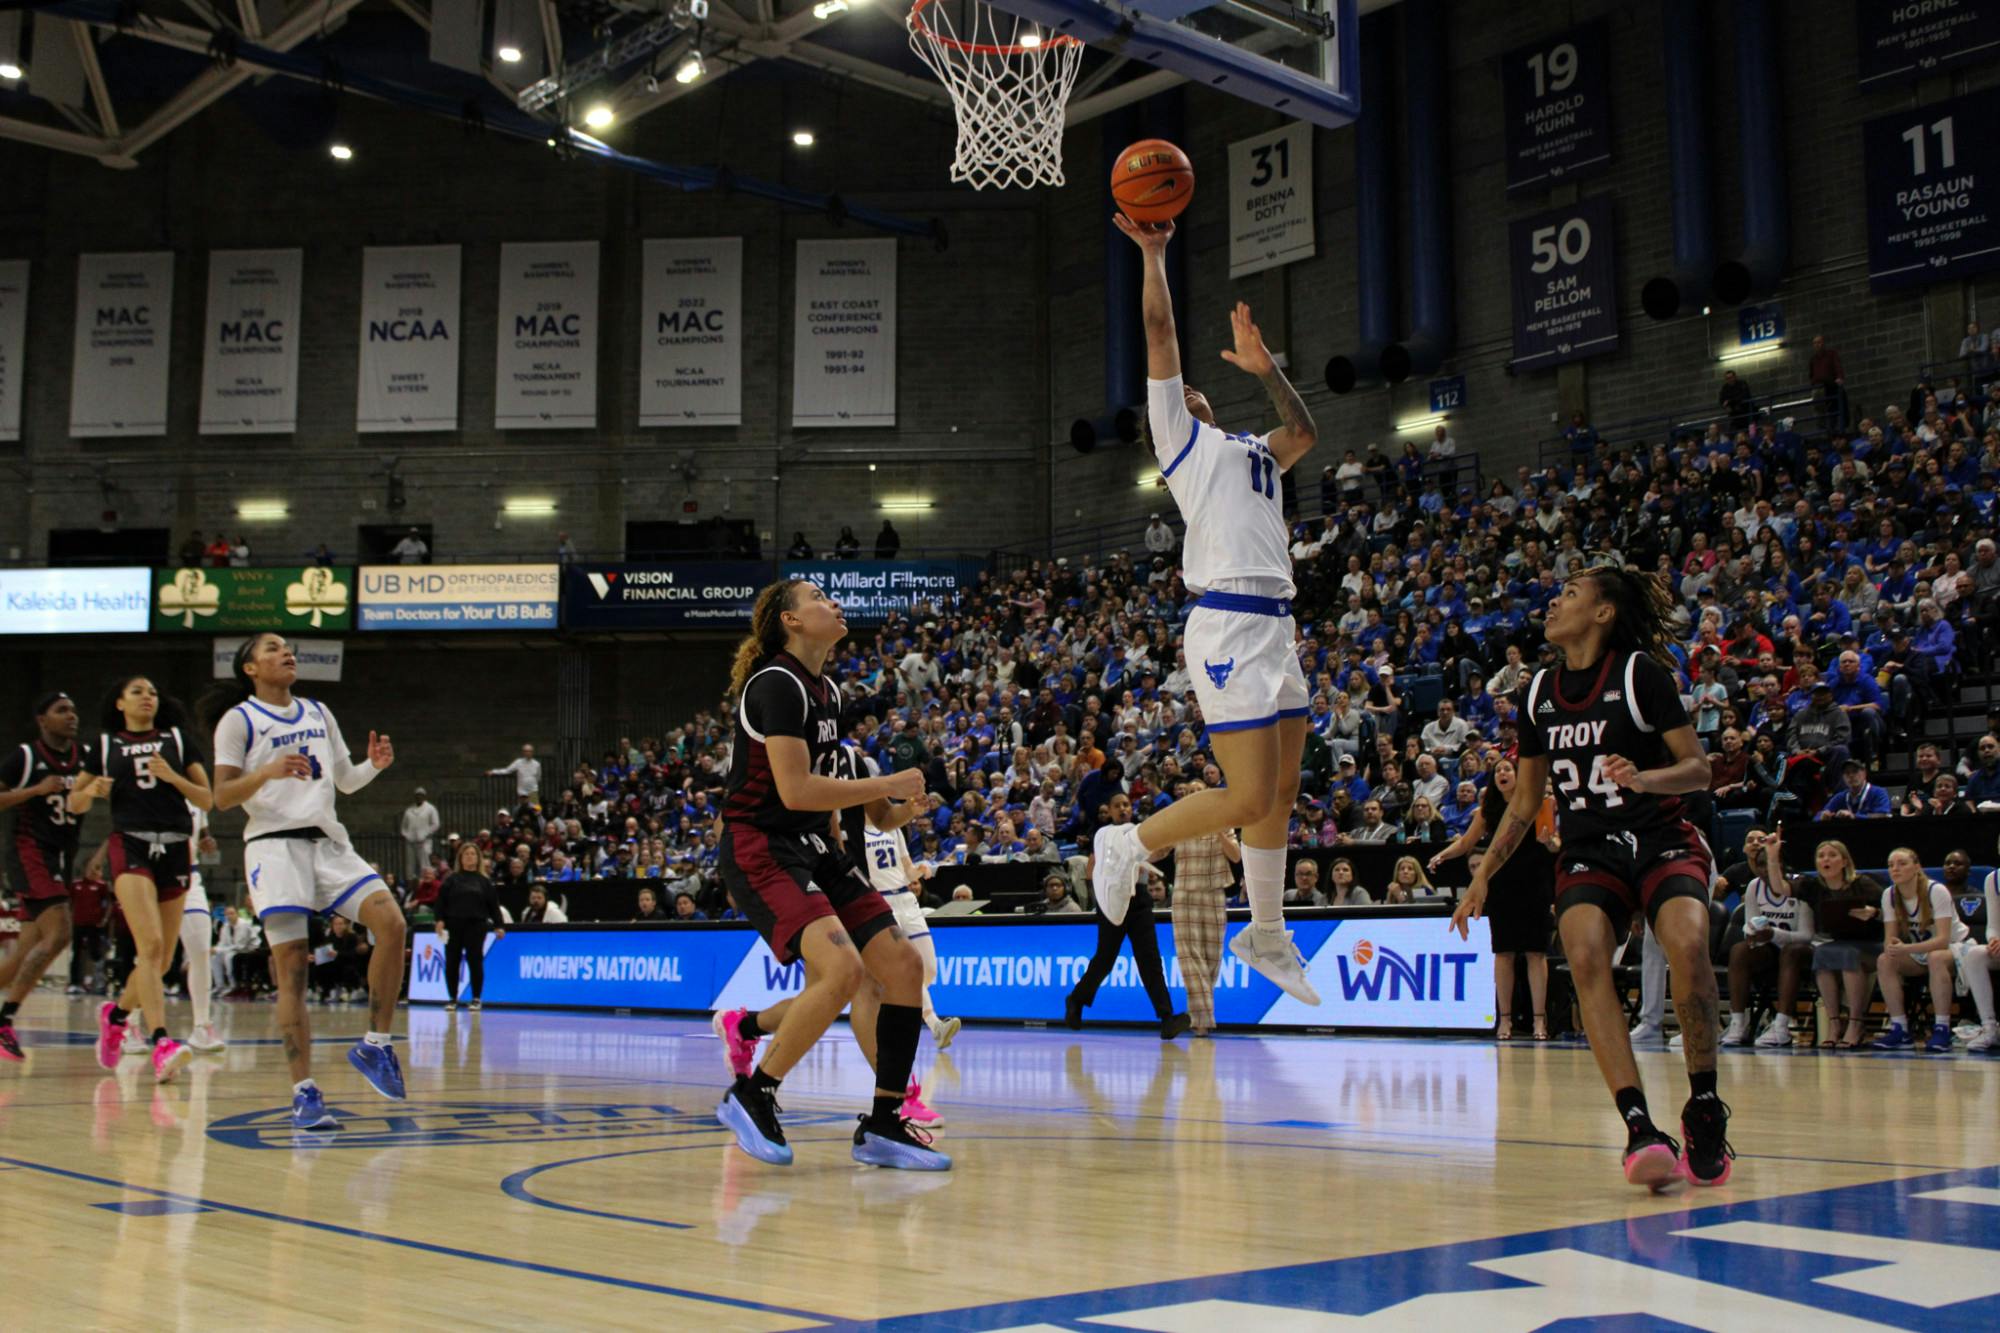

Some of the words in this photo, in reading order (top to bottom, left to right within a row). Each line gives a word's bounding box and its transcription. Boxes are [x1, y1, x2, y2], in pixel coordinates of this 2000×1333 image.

[1526, 43, 1579, 98] 19
[1525, 93, 1584, 125] HAROLD
[1535, 111, 1576, 136] KUHN
[1901, 115, 1955, 176] 11
[1250, 138, 1289, 187] 31
[1246, 187, 1295, 211] BRENNA
[1896, 174, 1975, 206] RASAUN
[1254, 202, 1287, 222] DOTY
[1901, 194, 1970, 221] YOUNG
[1888, 229, 1919, 243] MEN'S
[1920, 214, 1988, 239] BASKETBALL
[1530, 217, 1591, 274] 50
[819, 268, 872, 276] BASKETBALL
[1546, 274, 1577, 295] SAM
[811, 301, 838, 309] EAST
[842, 300, 879, 309] COAST
[1534, 286, 1591, 313] PELLOM
[97, 306, 150, 326] MAC
[515, 315, 580, 337] MAC
[658, 310, 723, 333] MAC
[808, 312, 882, 322] CONFERENCE
[1526, 319, 1550, 332] MEN'S
[1551, 307, 1602, 326] BASKETBALL
[220, 321, 283, 342] MAC
[369, 320, 449, 342] NCAA
[658, 335, 724, 345] CHAMPIONS
[812, 325, 879, 335] CHAMPIONS
[1748, 320, 1776, 340] 113
[515, 340, 581, 349] CHAMPIONS
[391, 373, 425, 381] SWEET
[513, 373, 581, 381] TOURNAMENT
[532, 363, 561, 371] NCAA
[656, 378, 725, 388] TOURNAMENT
[1437, 391, 1458, 408] 112
[1247, 449, 1274, 499] 11
[364, 574, 401, 594] UB
[409, 574, 445, 593] MD
[448, 573, 557, 585] ORTHOPAEDICS
[624, 572, 673, 585] VISION
[831, 572, 886, 588] Millard
[890, 572, 955, 588] Fillmore
[6, 591, 77, 611] Kaleida
[84, 591, 146, 611] Health
[623, 587, 698, 600] FINANCIAL
[702, 585, 754, 598] GROUP
[830, 591, 908, 607] Suburban
[363, 608, 393, 620] Team
[395, 608, 441, 620] Doctors
[443, 607, 461, 620] for
[462, 605, 495, 619] Your
[496, 605, 518, 619] UB
[520, 605, 553, 619] Bulls
[271, 728, 325, 748] BUFFALO
[1546, 719, 1608, 751] TROY
[121, 741, 164, 757] TROY
[133, 755, 158, 790] 5
[1551, 754, 1624, 811] 24
[875, 847, 896, 869] 21
[519, 955, 593, 979] WOMEN'S
[596, 955, 682, 982] NATIONAL
[1337, 946, 1477, 1001] WNIT
